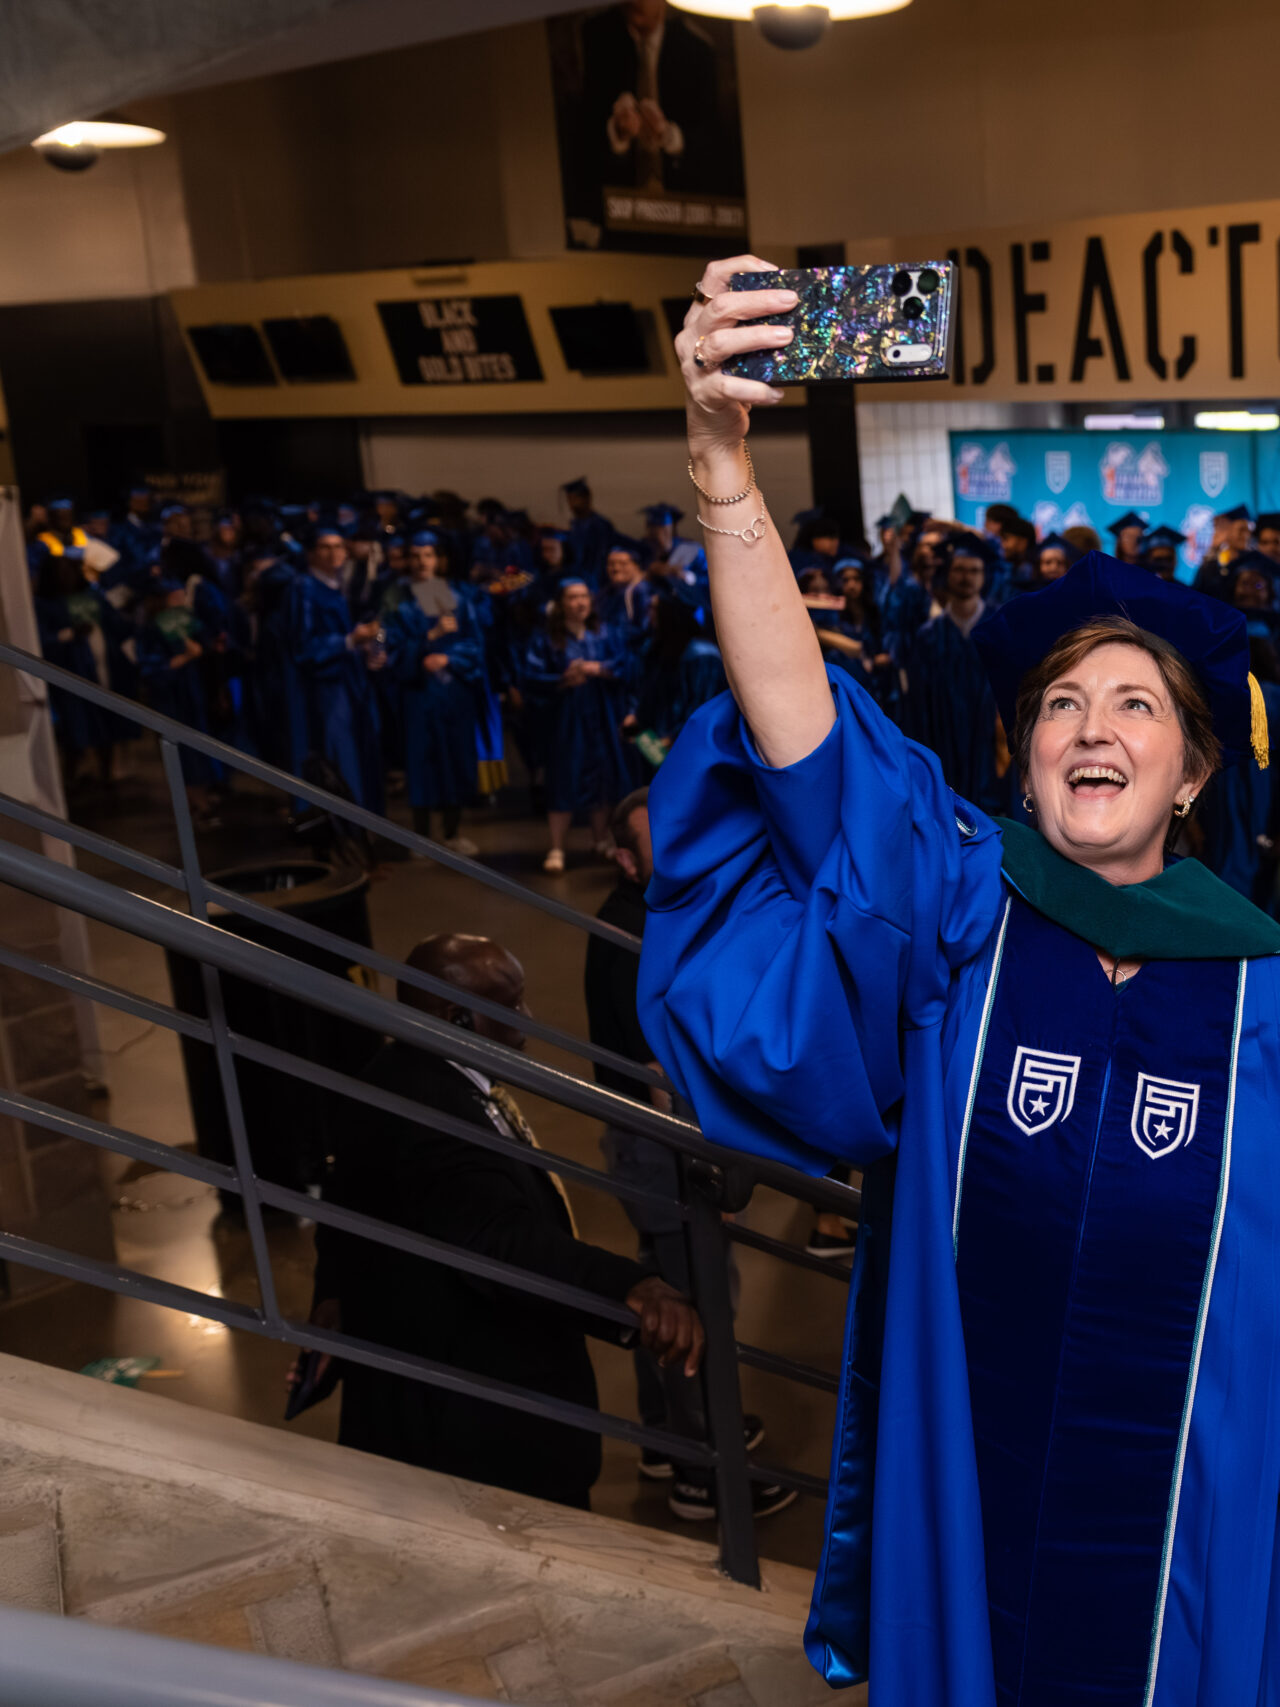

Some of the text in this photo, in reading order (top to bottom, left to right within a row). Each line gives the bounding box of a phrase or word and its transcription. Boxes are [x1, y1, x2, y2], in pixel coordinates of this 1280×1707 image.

[418, 300, 478, 329] BLACK
[440, 328, 478, 353] AND
[418, 354, 464, 382] GOLD
